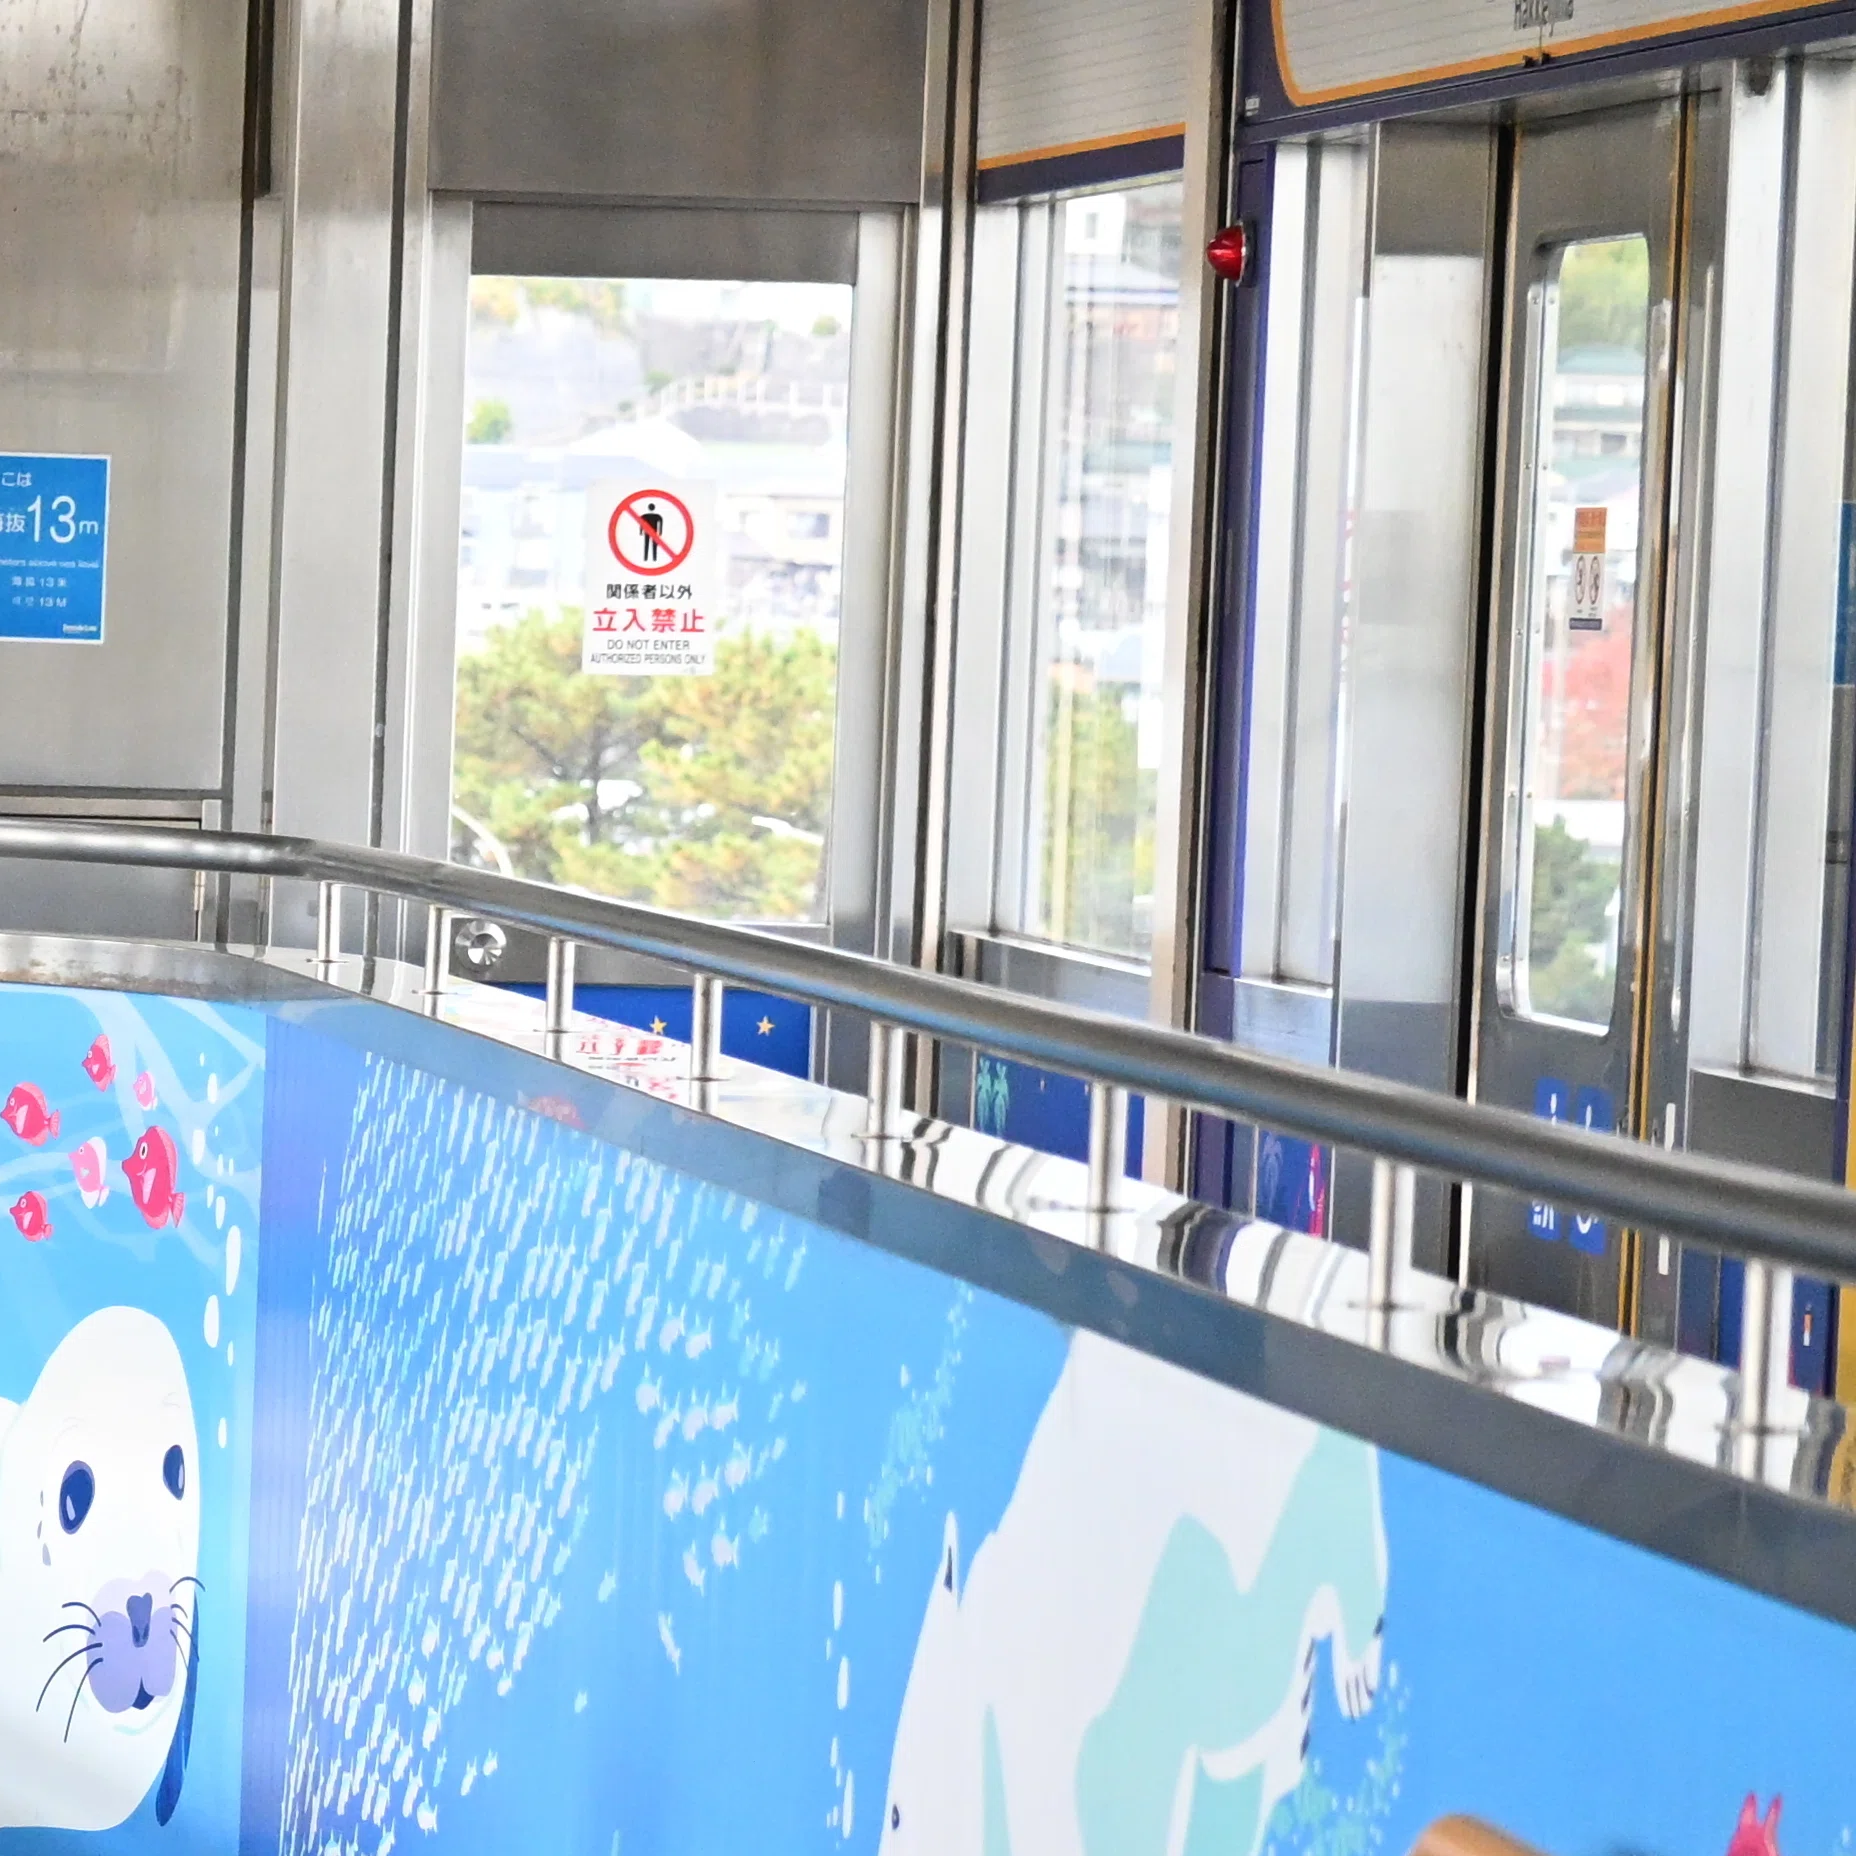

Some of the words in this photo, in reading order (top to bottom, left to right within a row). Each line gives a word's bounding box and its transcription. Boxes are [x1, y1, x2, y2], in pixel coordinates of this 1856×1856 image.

[606, 584, 692, 600] 関係者以外
[592, 608, 705, 633] 立入禁止
[607, 639, 623, 650] DO
[627, 639, 649, 650] NOT
[653, 640, 690, 651] ENTER
[590, 653, 641, 664] AUTHORIZED
[644, 653, 682, 665] PERSONS
[685, 654, 706, 665] ONLY
